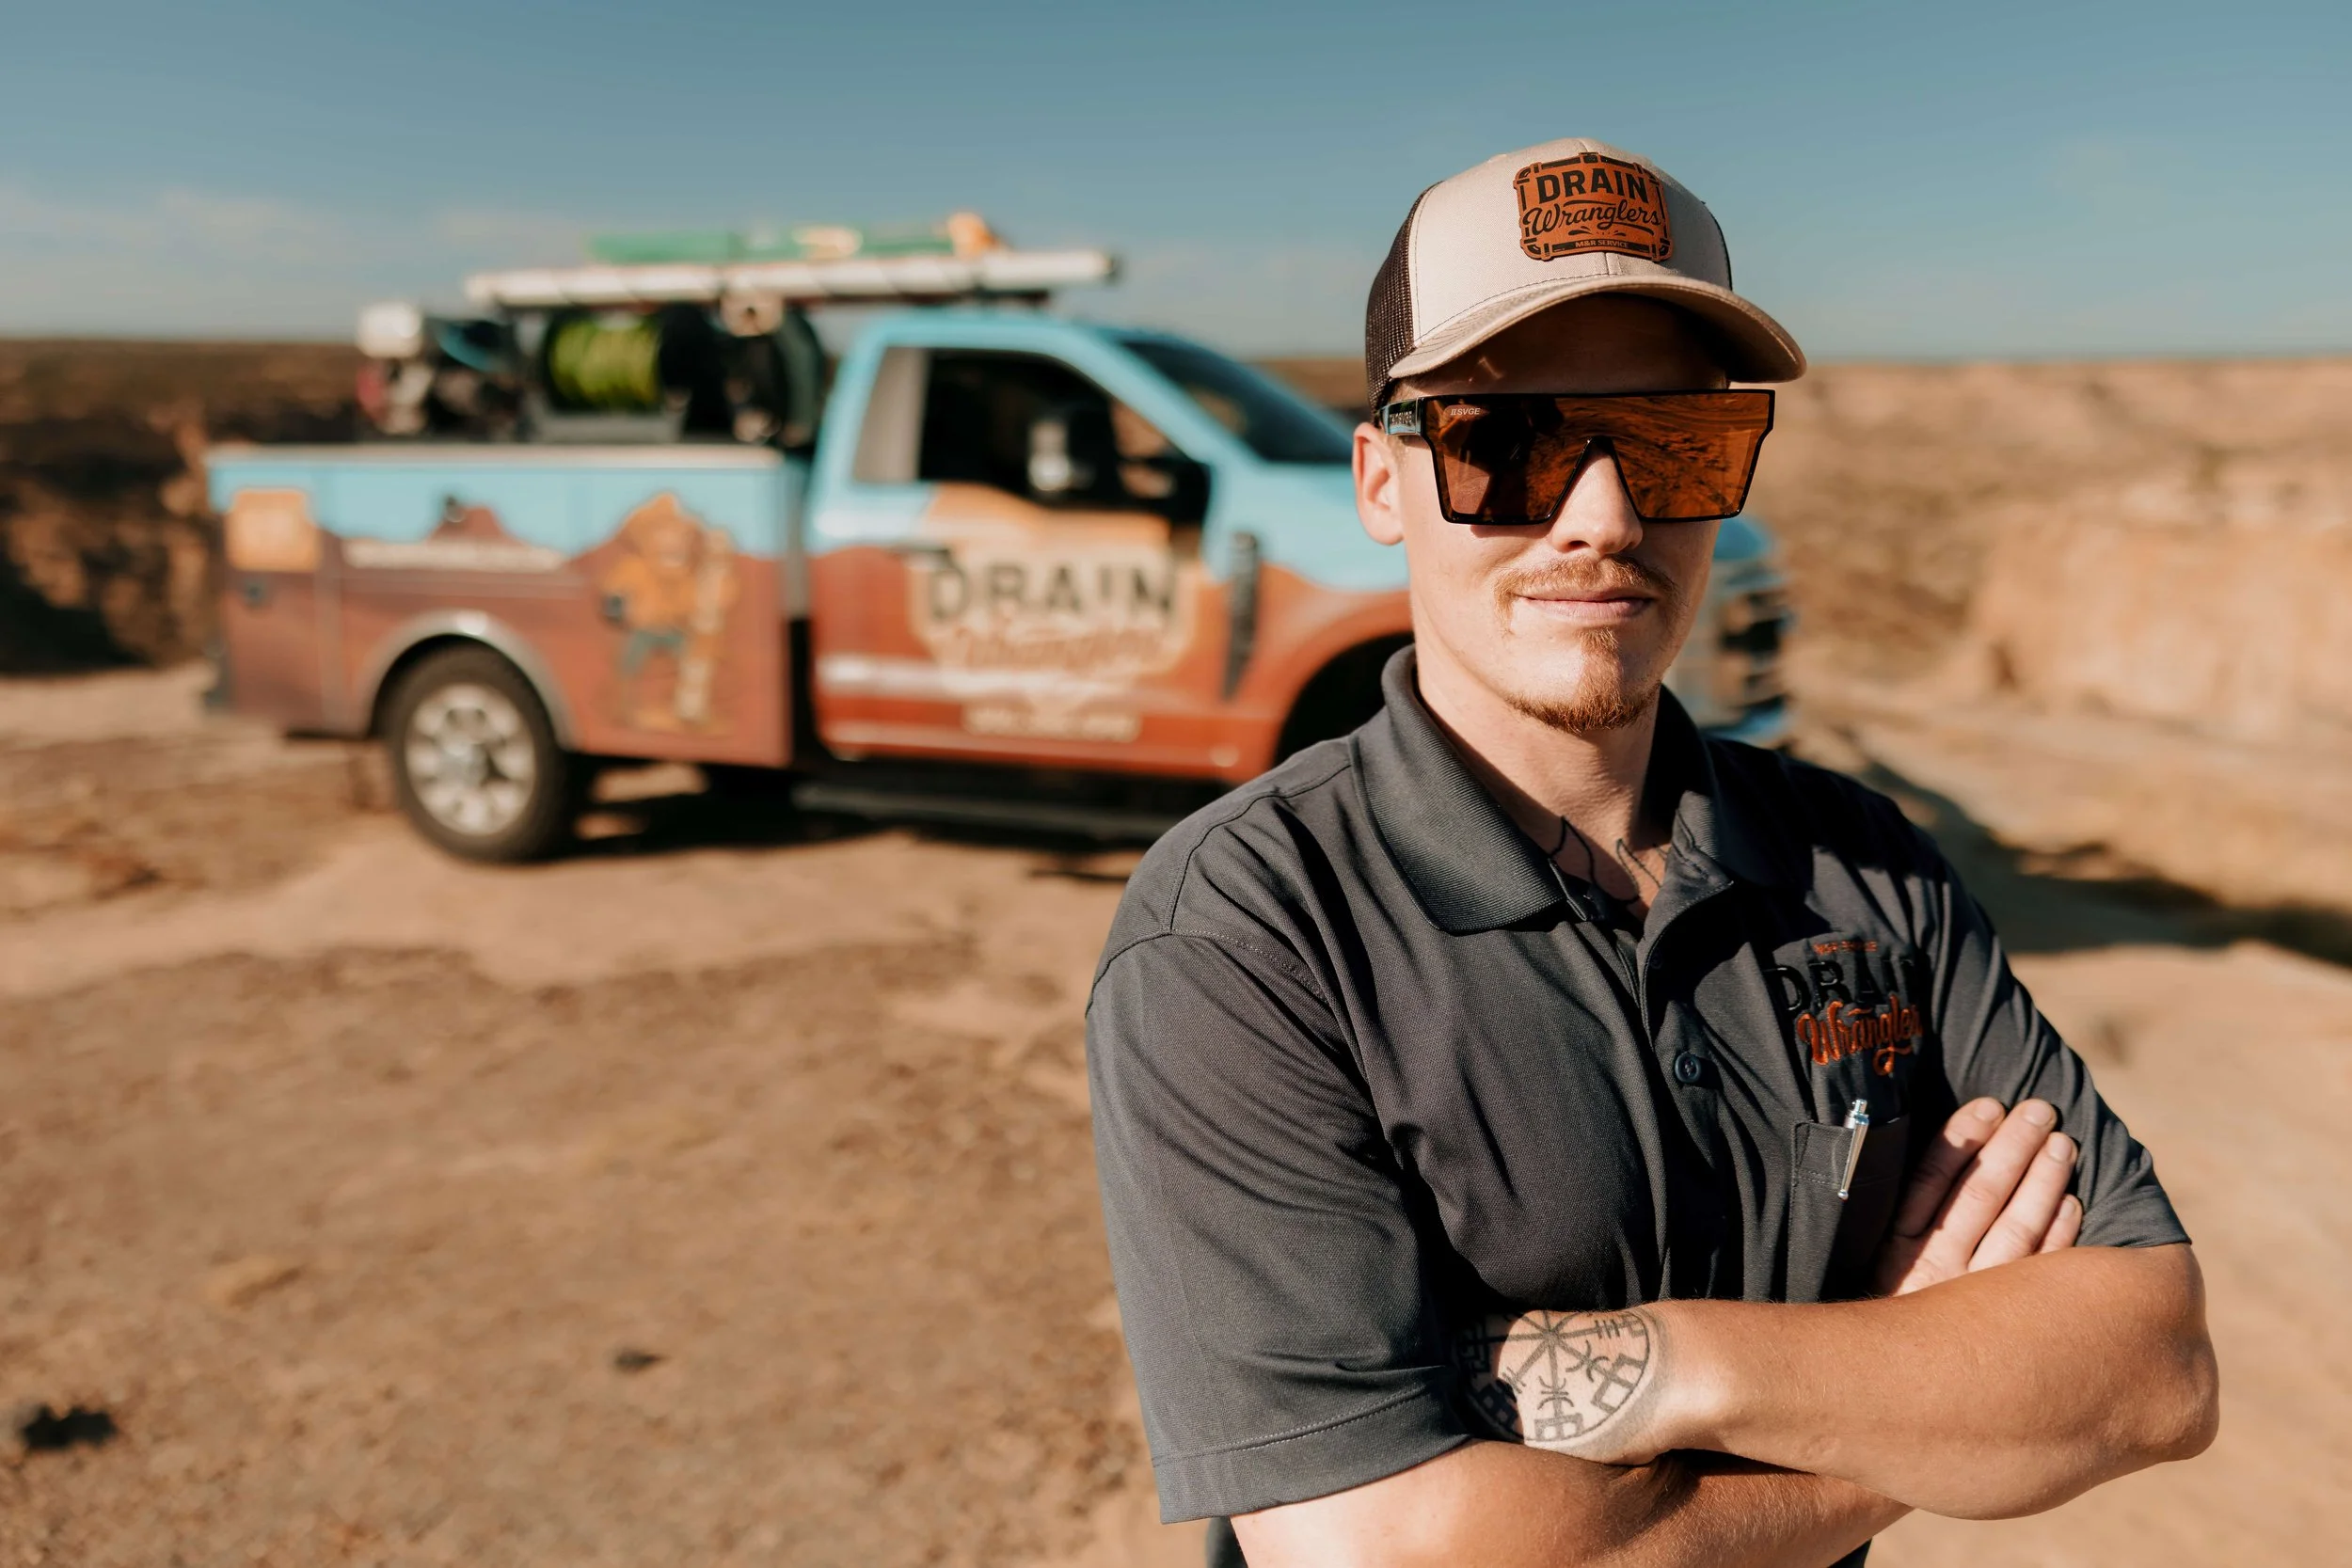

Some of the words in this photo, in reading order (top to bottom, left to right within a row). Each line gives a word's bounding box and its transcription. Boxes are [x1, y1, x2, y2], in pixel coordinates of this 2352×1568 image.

[1535, 167, 1649, 204] DRAIN
[1522, 199, 1661, 235] Wranglers
[1575, 240, 1597, 248] M&R
[1597, 240, 1629, 248] SERVICE
[928, 562, 1177, 621] DRAIN
[1796, 992, 1924, 1075] Wrangler
